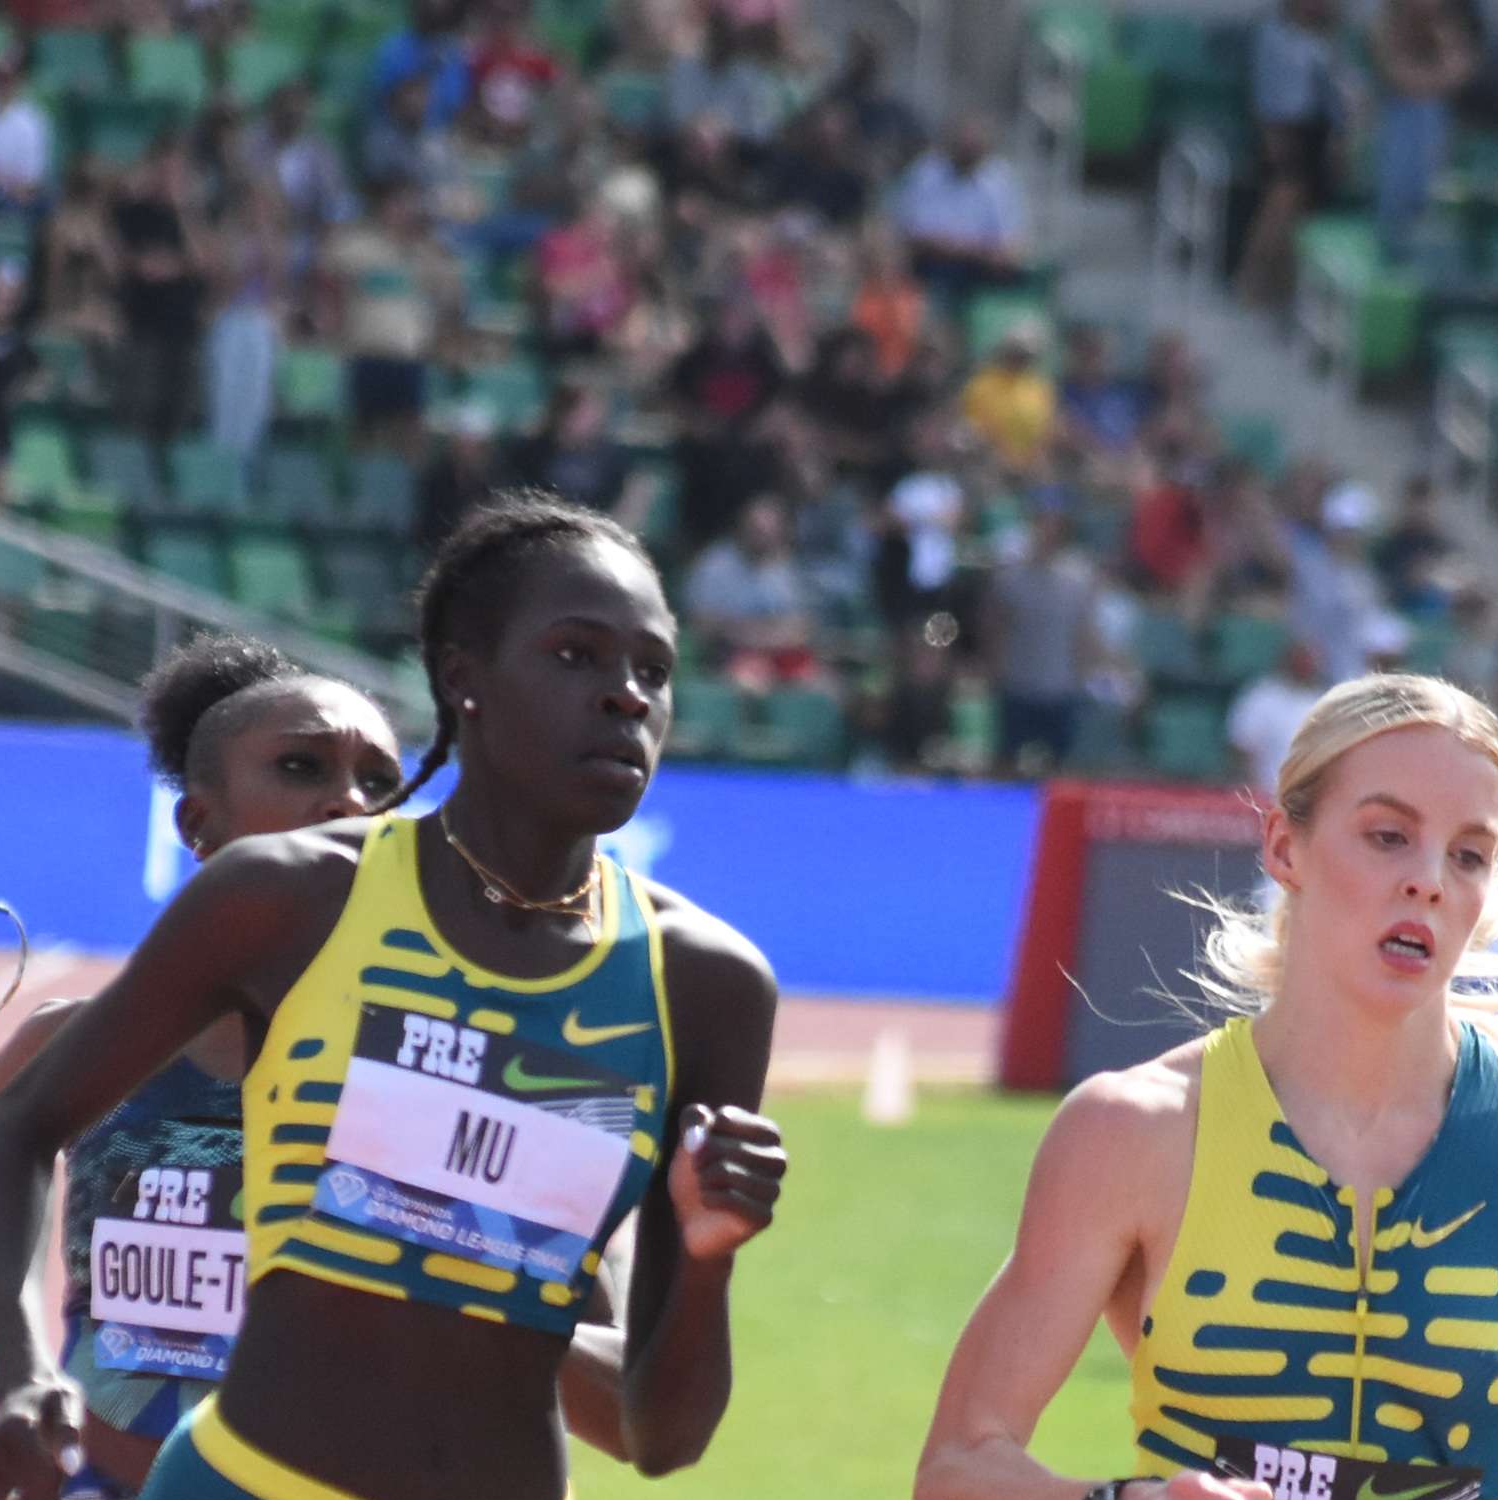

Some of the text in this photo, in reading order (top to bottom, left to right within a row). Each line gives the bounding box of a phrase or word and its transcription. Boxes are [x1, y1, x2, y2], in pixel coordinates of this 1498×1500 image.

[397, 1013, 488, 1086] PRE
[446, 1110, 516, 1184] MU
[133, 1167, 213, 1225] PRE
